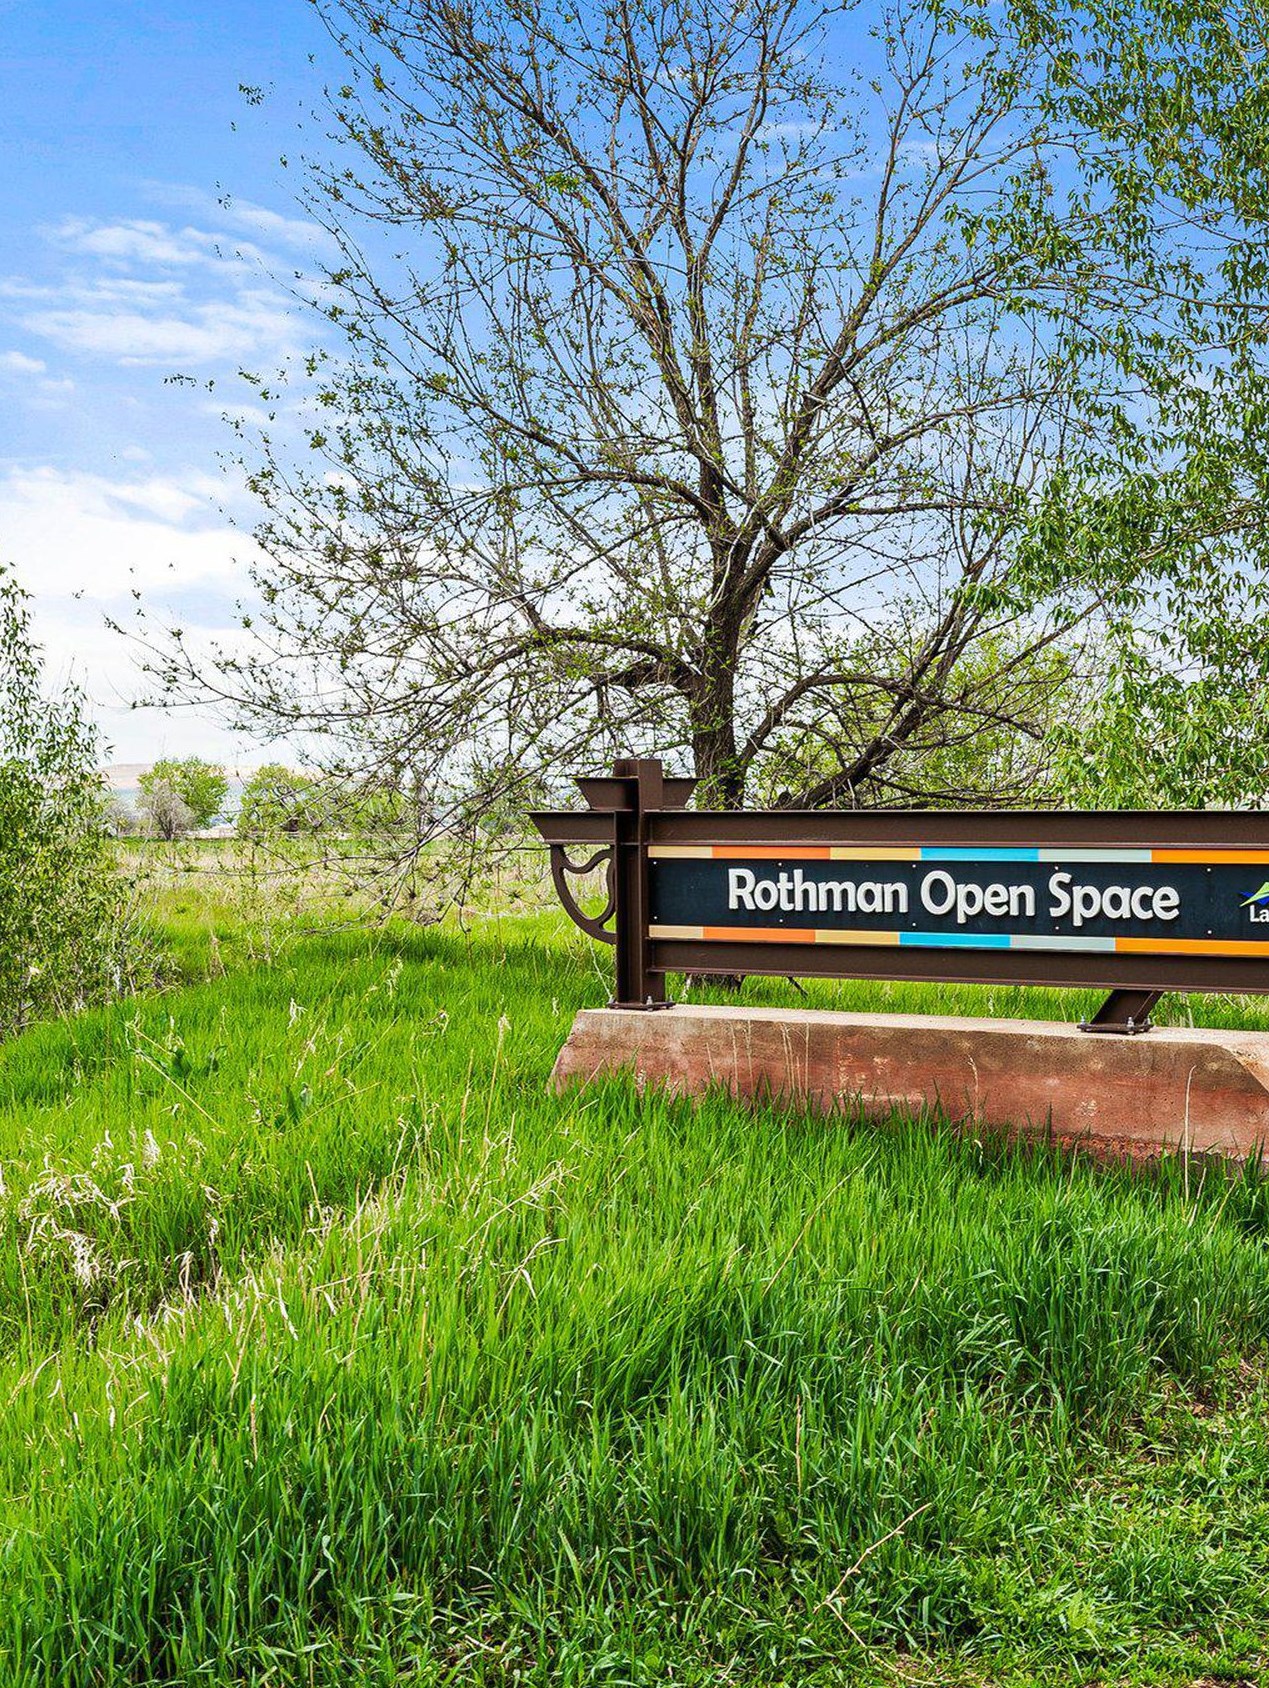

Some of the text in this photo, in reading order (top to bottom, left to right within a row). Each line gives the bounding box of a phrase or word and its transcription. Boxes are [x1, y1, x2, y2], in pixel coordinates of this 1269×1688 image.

[728, 868, 1181, 926] Rothman Open Space
